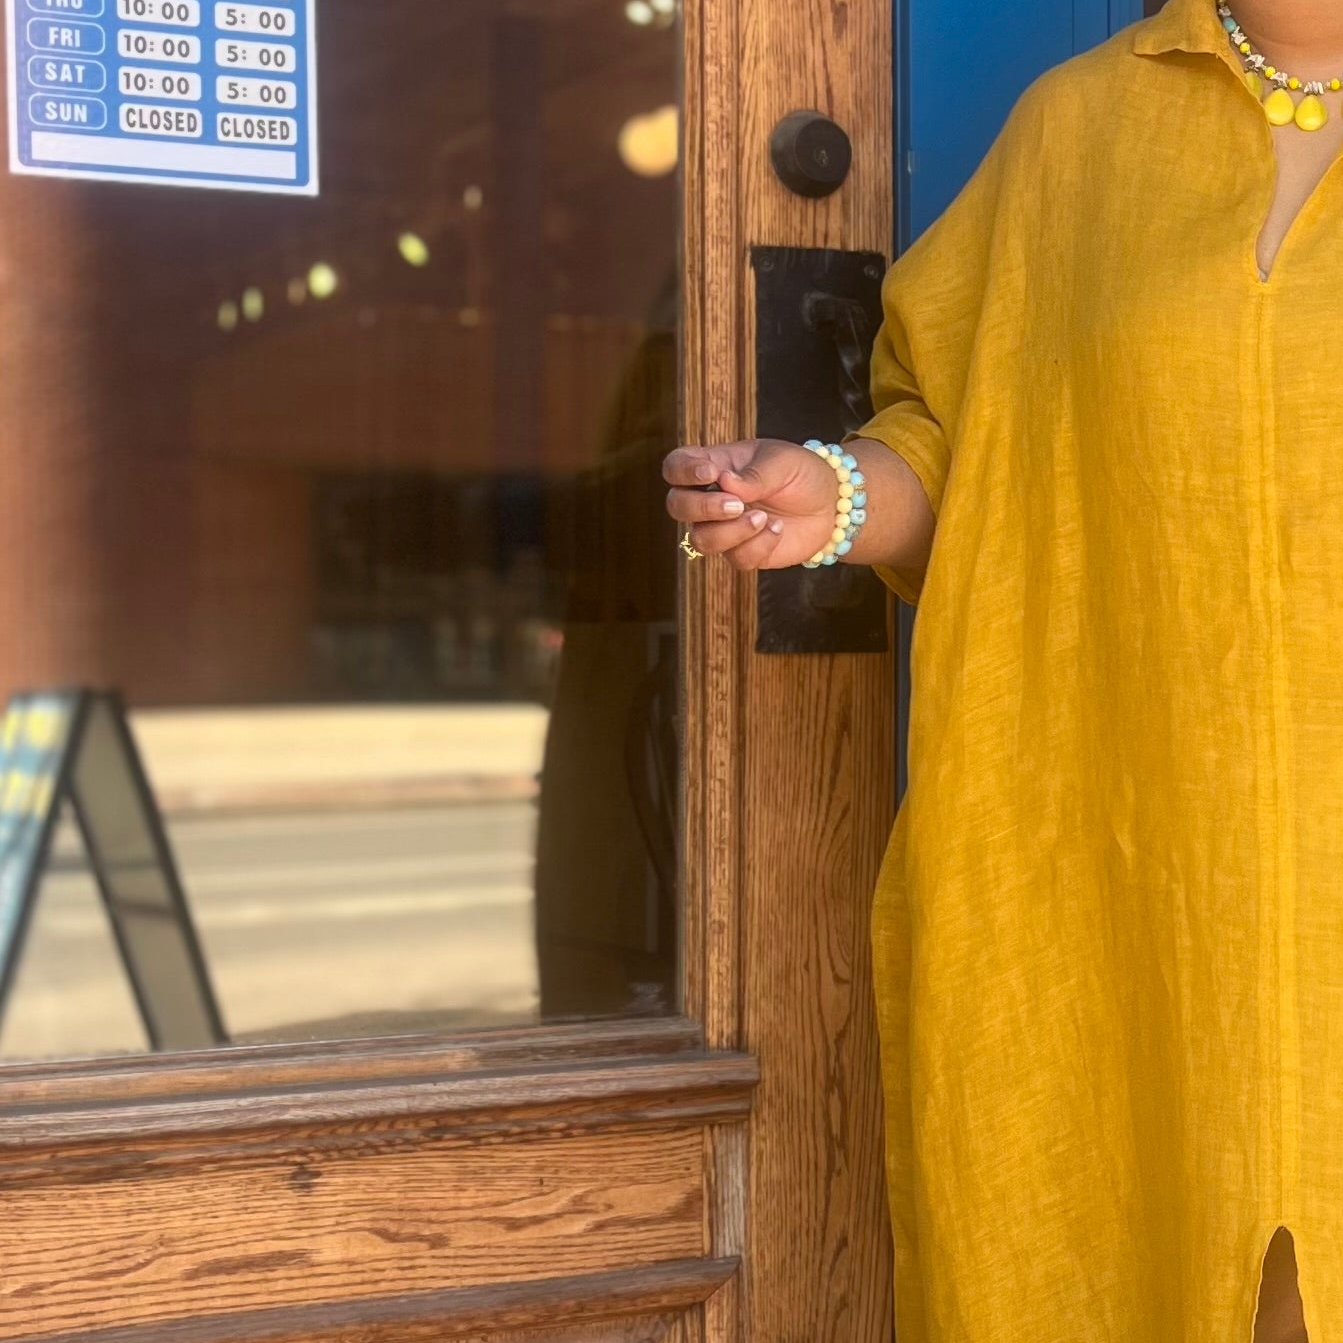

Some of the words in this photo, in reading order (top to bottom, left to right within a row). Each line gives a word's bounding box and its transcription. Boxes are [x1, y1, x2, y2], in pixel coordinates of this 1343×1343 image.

[49, 26, 81, 48] FRI
[44, 62, 86, 84] SAT
[44, 100, 88, 123] SUN
[125, 108, 198, 134] CLOSED
[220, 116, 291, 140] CLOSED
